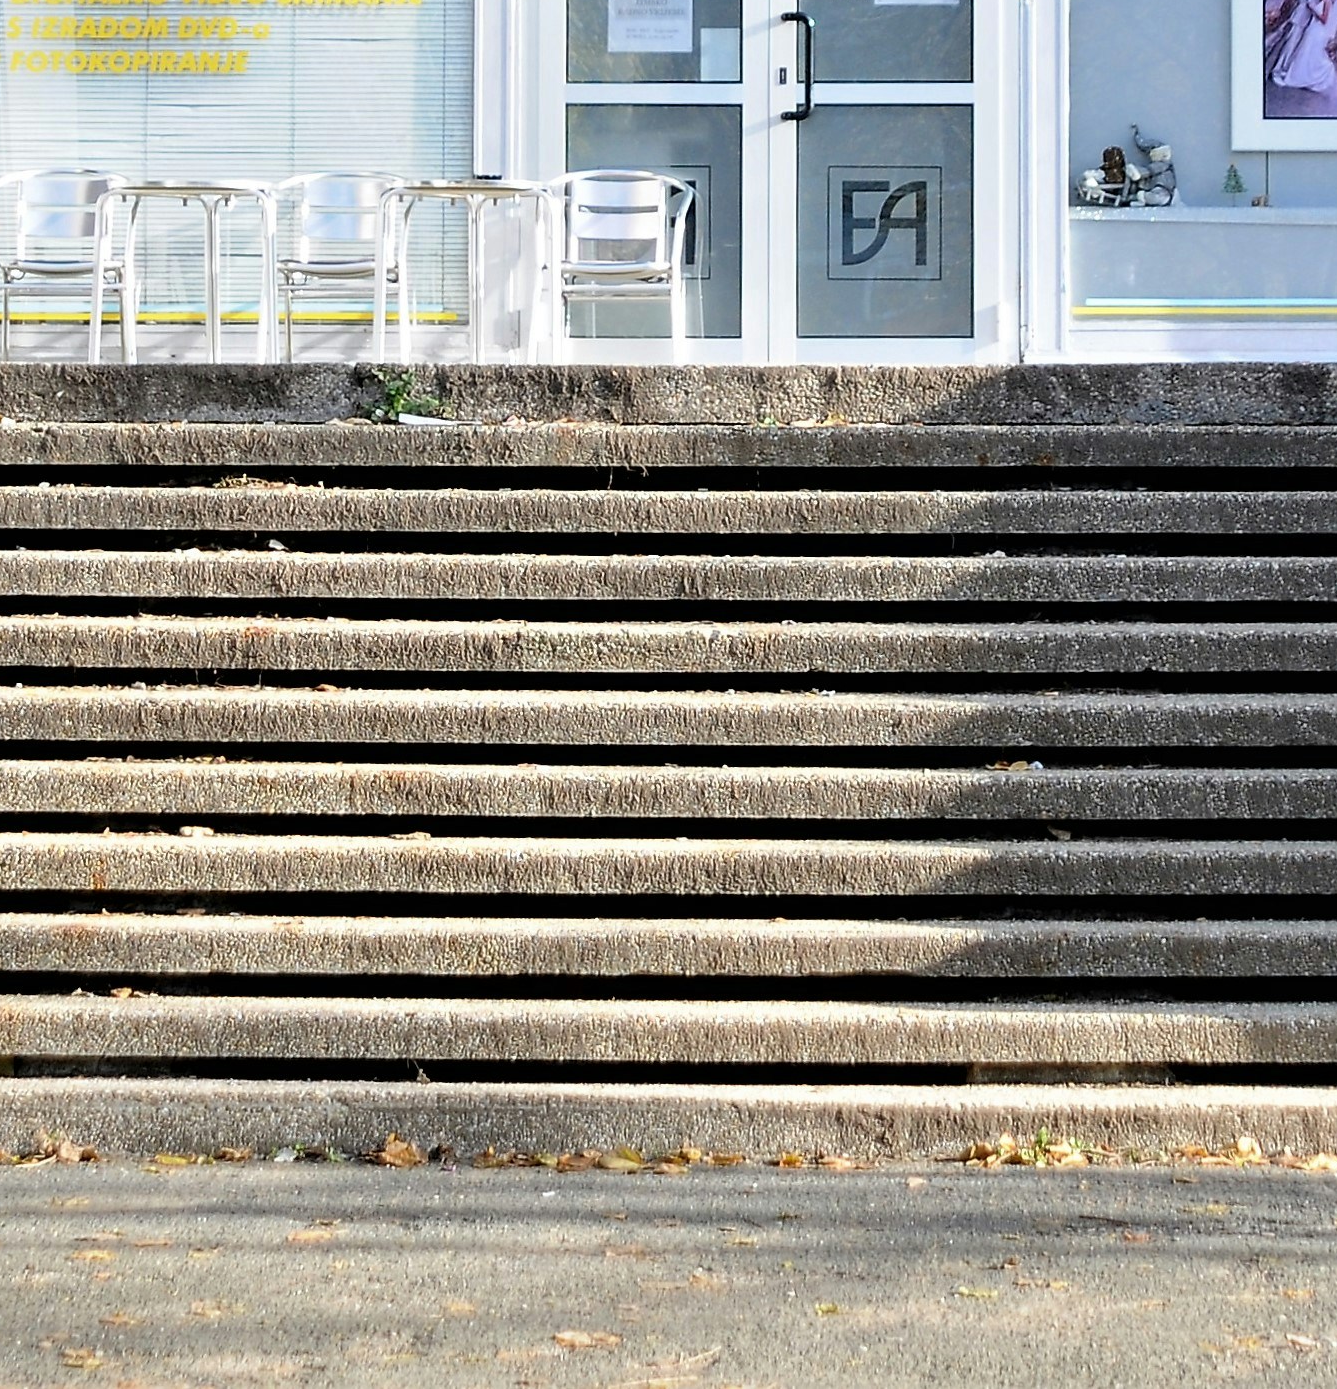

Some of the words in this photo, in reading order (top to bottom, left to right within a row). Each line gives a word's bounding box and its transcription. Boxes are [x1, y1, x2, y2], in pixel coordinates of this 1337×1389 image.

[6, 17, 22, 39] S
[31, 17, 168, 39] IZRADOM
[178, 17, 271, 39] DVD-a
[9, 50, 249, 73] FOTOKOPIRANJE
